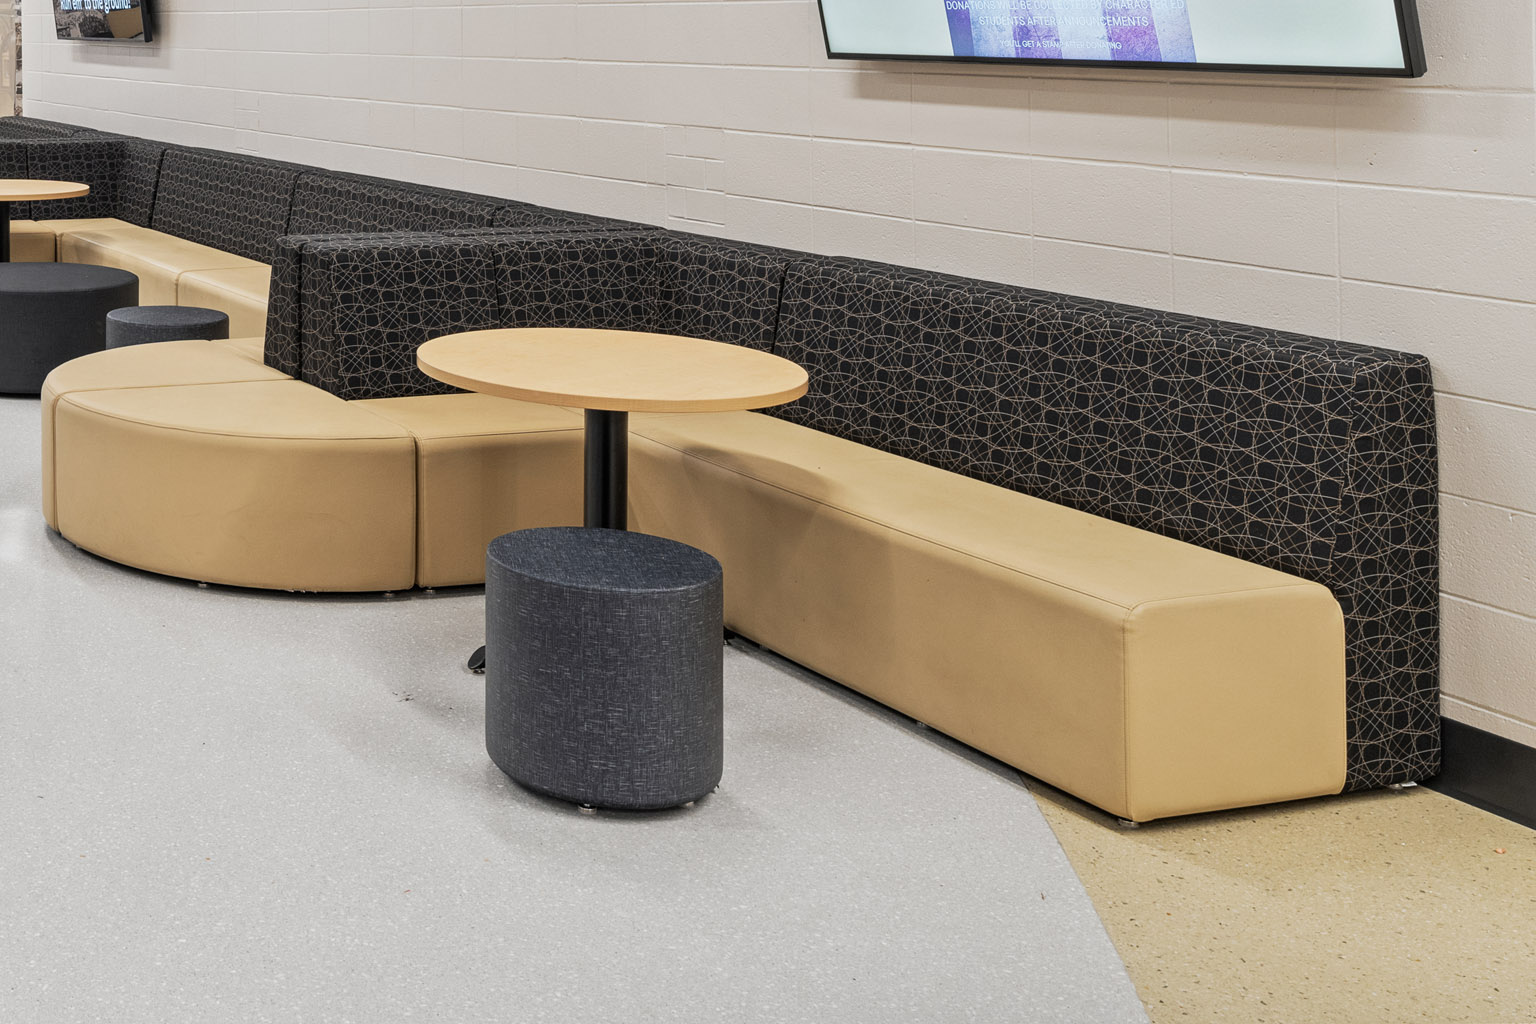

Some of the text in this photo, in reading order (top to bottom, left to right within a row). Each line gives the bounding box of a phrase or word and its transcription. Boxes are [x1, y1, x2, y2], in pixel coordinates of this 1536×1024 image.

[945, 0, 997, 10] DONATIONS
[1020, 0, 1032, 10] BE
[1033, 0, 1089, 10] COLLECTED
[1091, 0, 1102, 9] BY
[978, 15, 1149, 27] STUDENTS AFTER ANNOUNCEMENTS
[1021, 40, 1035, 48] GET
